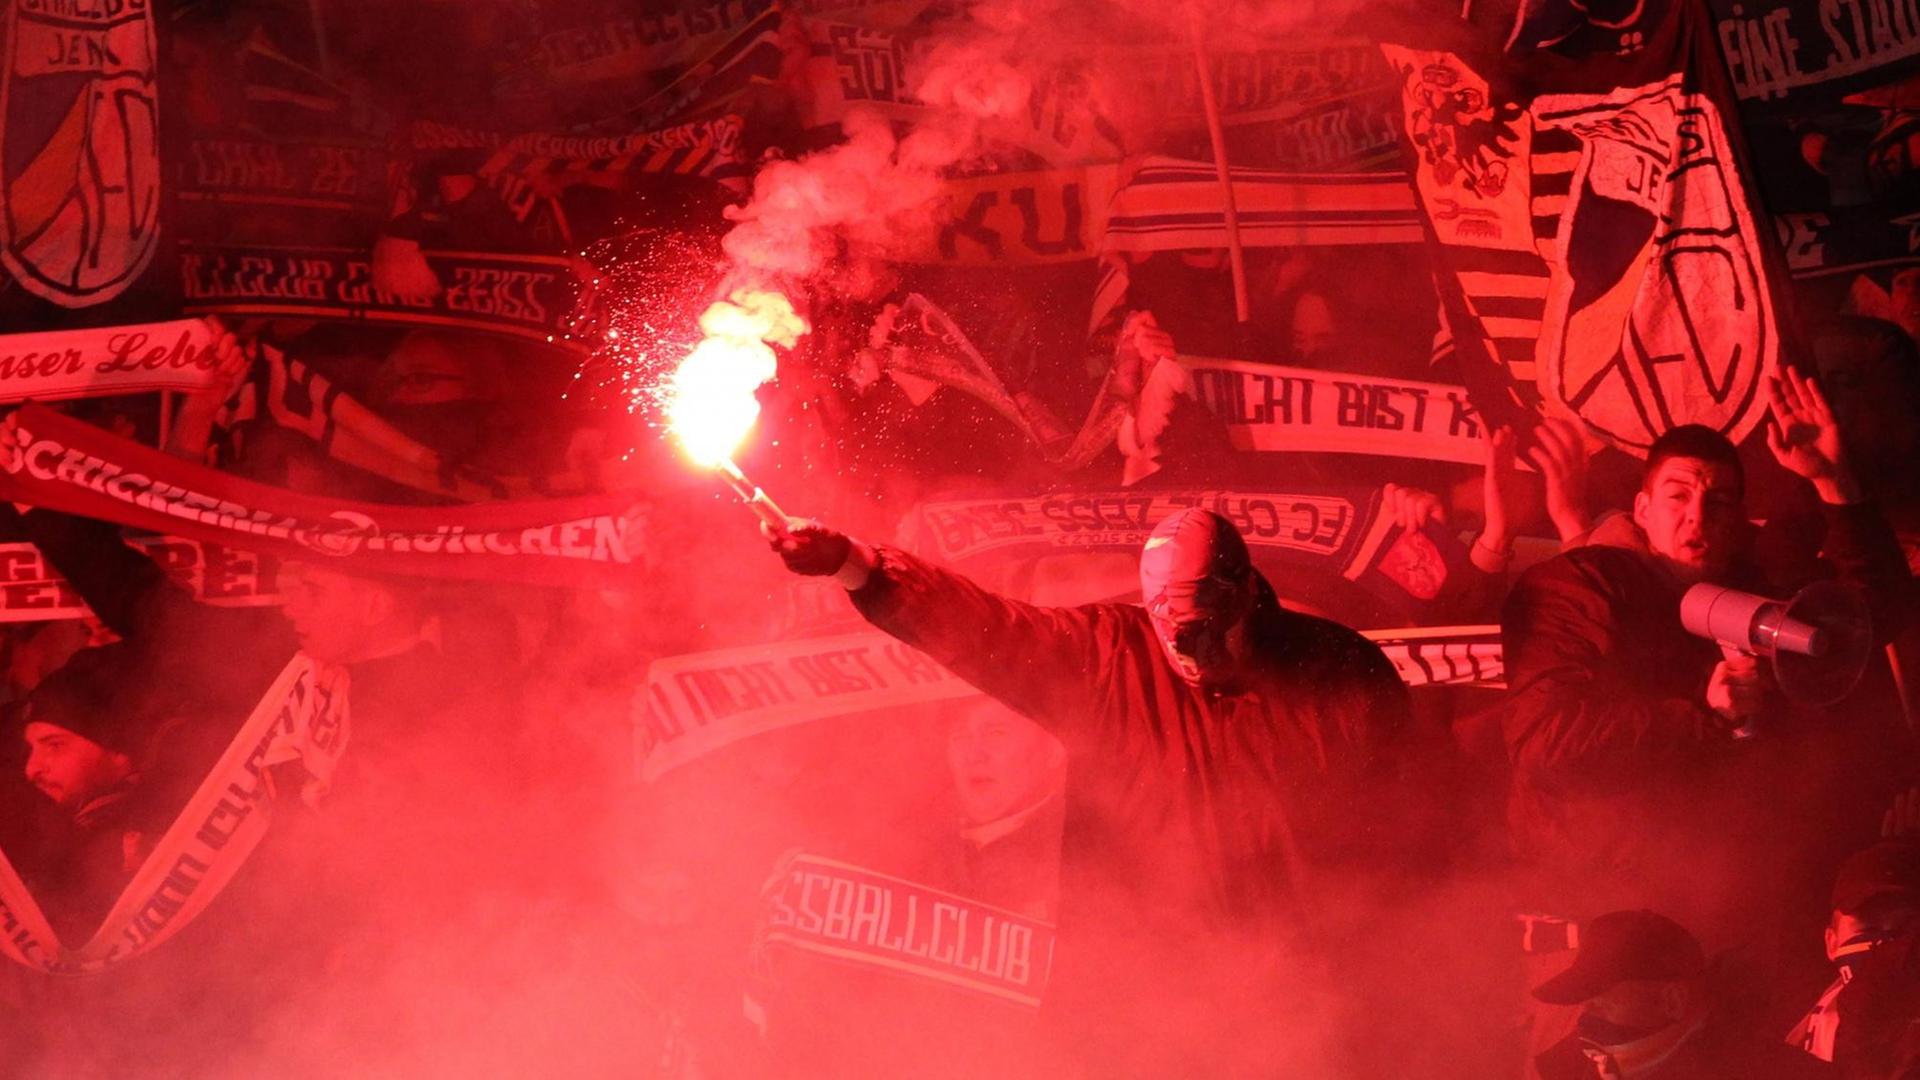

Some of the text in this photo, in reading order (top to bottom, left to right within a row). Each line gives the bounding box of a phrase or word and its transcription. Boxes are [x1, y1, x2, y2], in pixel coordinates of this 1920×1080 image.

[446, 267, 555, 323] ZEISS
[1332, 380, 1429, 433] BIST
[1446, 391, 1483, 439] K
[1041, 498, 1161, 533] ZEISS
[1291, 503, 1348, 548] FC
[787, 647, 890, 699] BIST
